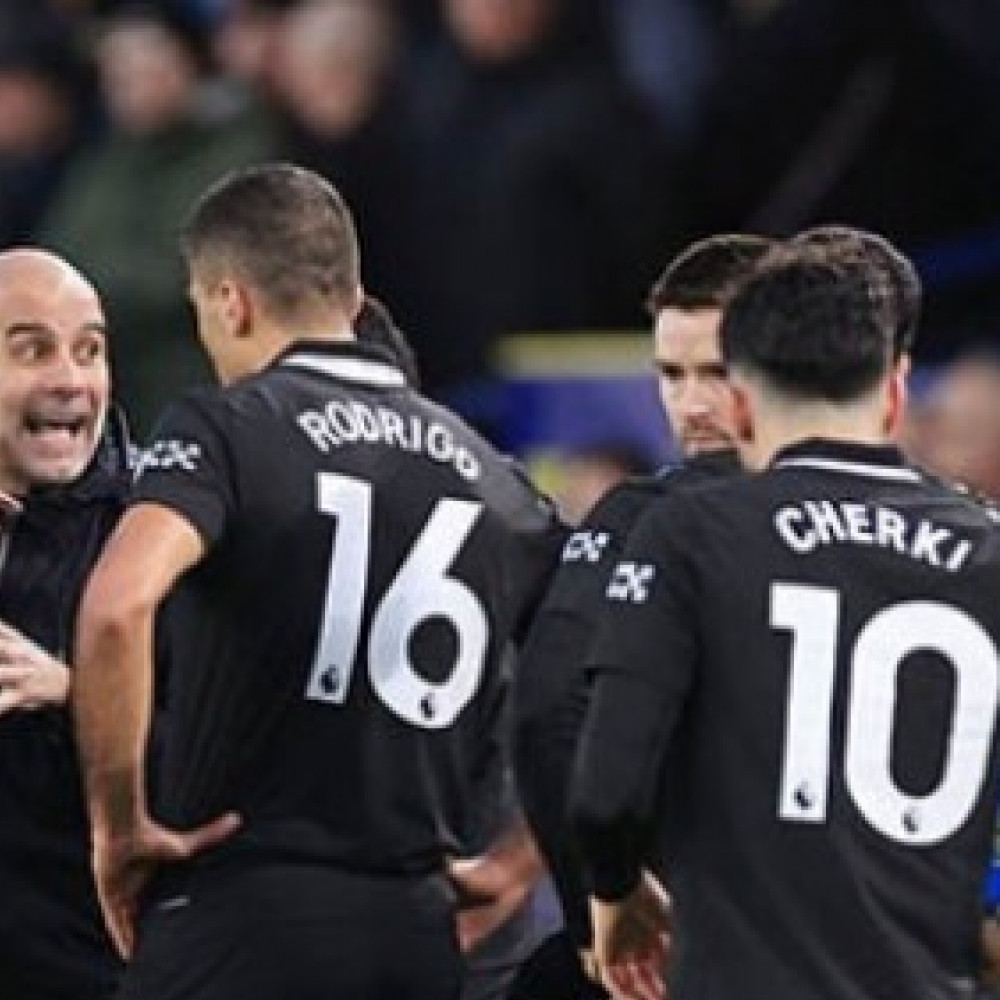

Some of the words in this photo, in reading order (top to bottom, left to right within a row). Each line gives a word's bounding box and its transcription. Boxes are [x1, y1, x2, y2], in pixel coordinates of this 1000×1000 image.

[296, 401, 481, 480] RODRIGO
[304, 472, 489, 729] 16
[774, 499, 972, 572] CHERKI
[769, 579, 1000, 846] 10
